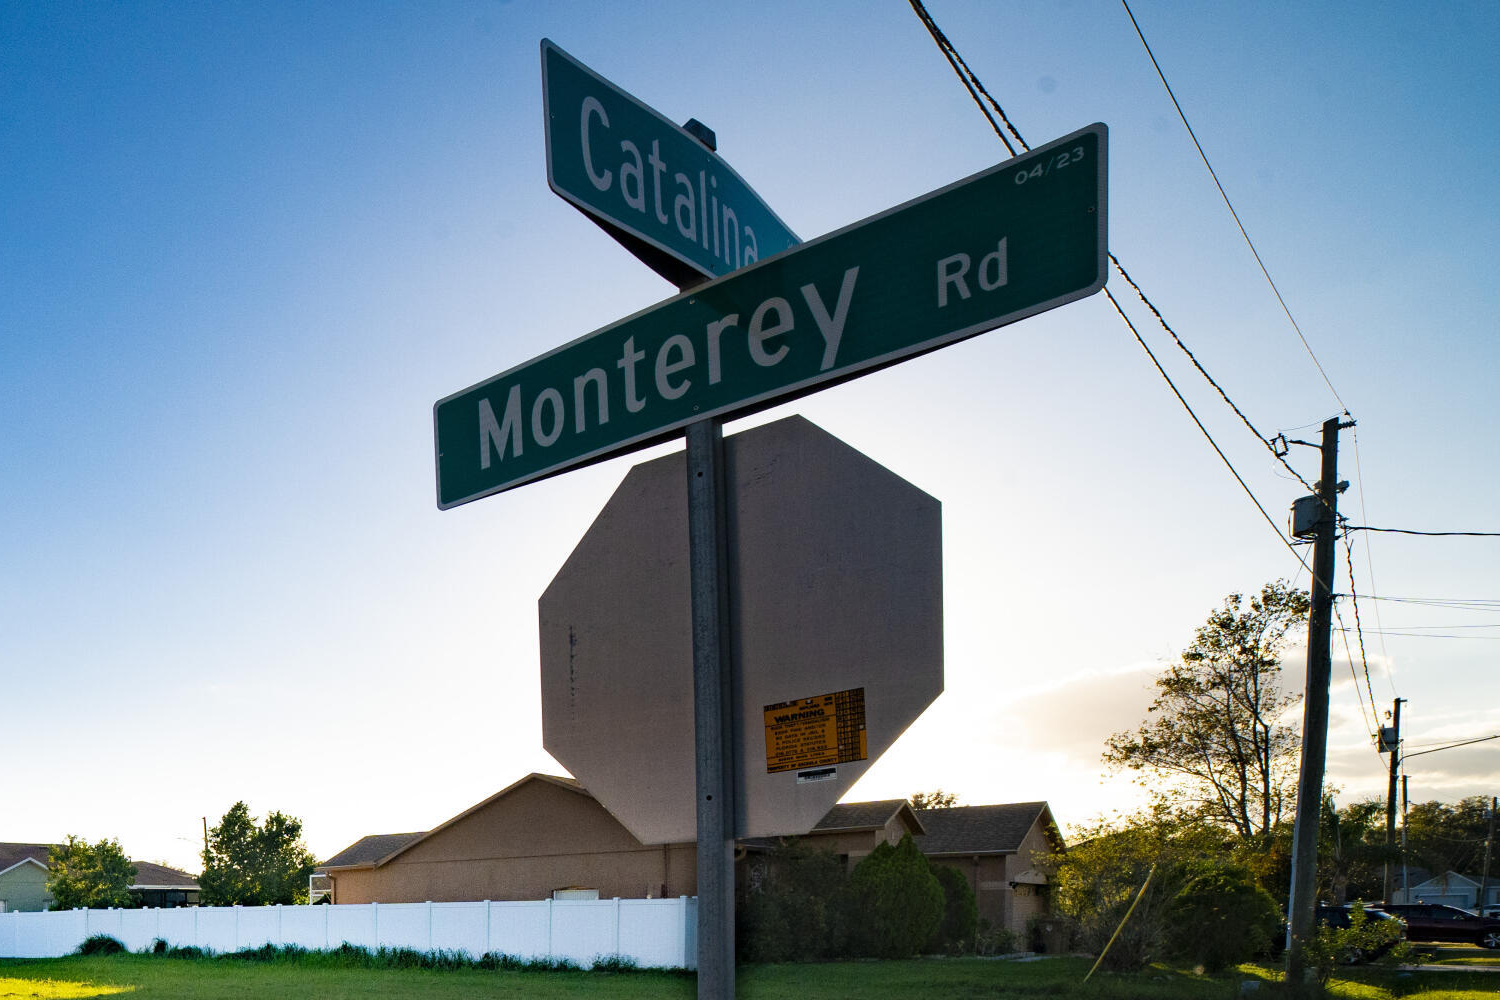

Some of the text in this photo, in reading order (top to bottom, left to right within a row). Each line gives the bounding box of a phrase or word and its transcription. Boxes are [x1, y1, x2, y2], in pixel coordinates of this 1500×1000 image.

[580, 96, 759, 271] Catalina
[1014, 146, 1085, 185] 04/23
[478, 236, 1008, 470] Monterey Rd
[774, 708, 825, 723] WARNING
